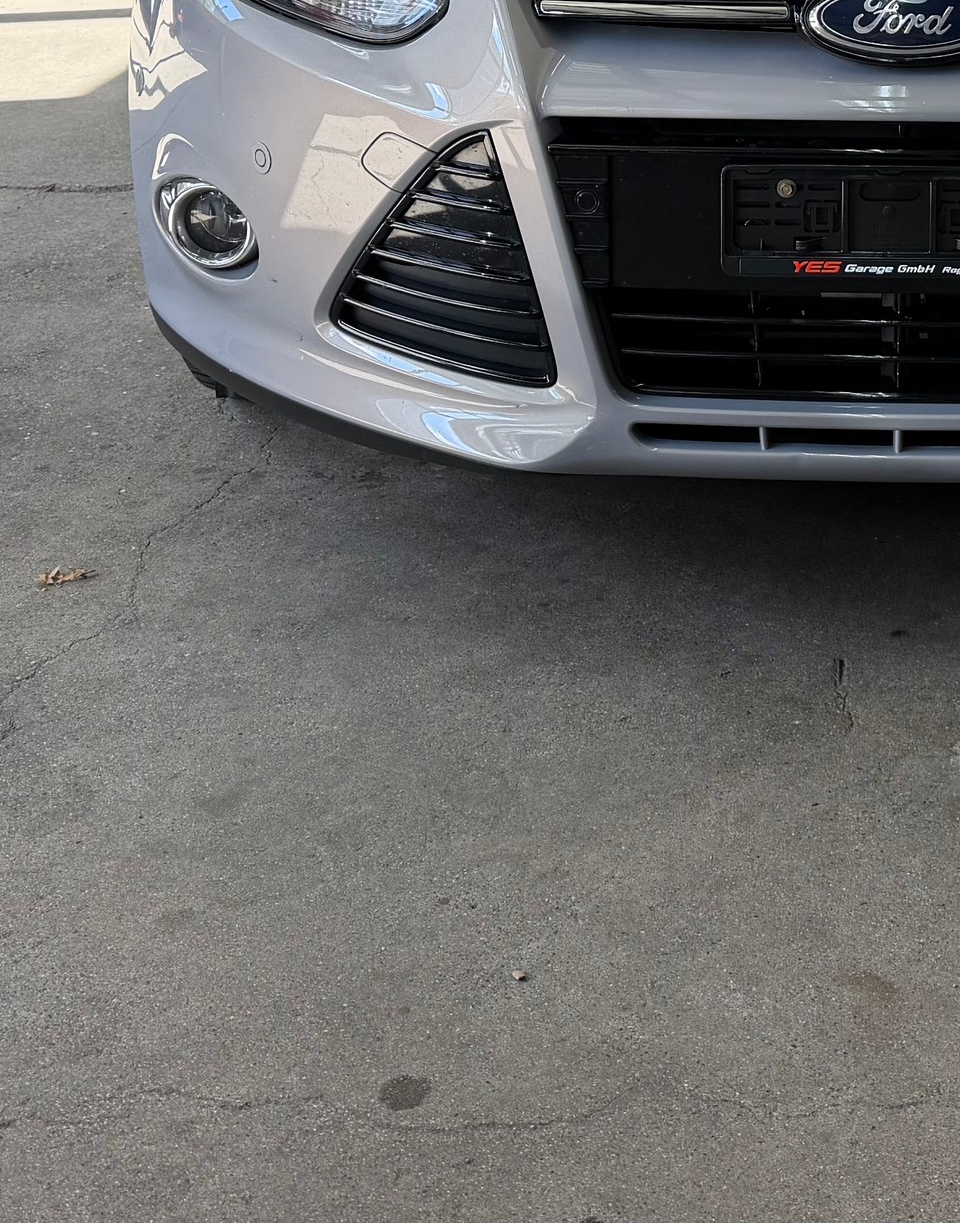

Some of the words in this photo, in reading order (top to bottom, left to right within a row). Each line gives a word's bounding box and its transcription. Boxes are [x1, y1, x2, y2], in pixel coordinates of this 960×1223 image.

[793, 261, 842, 273] YES
[845, 264, 894, 275] Garage
[897, 265, 936, 274] GmbH
